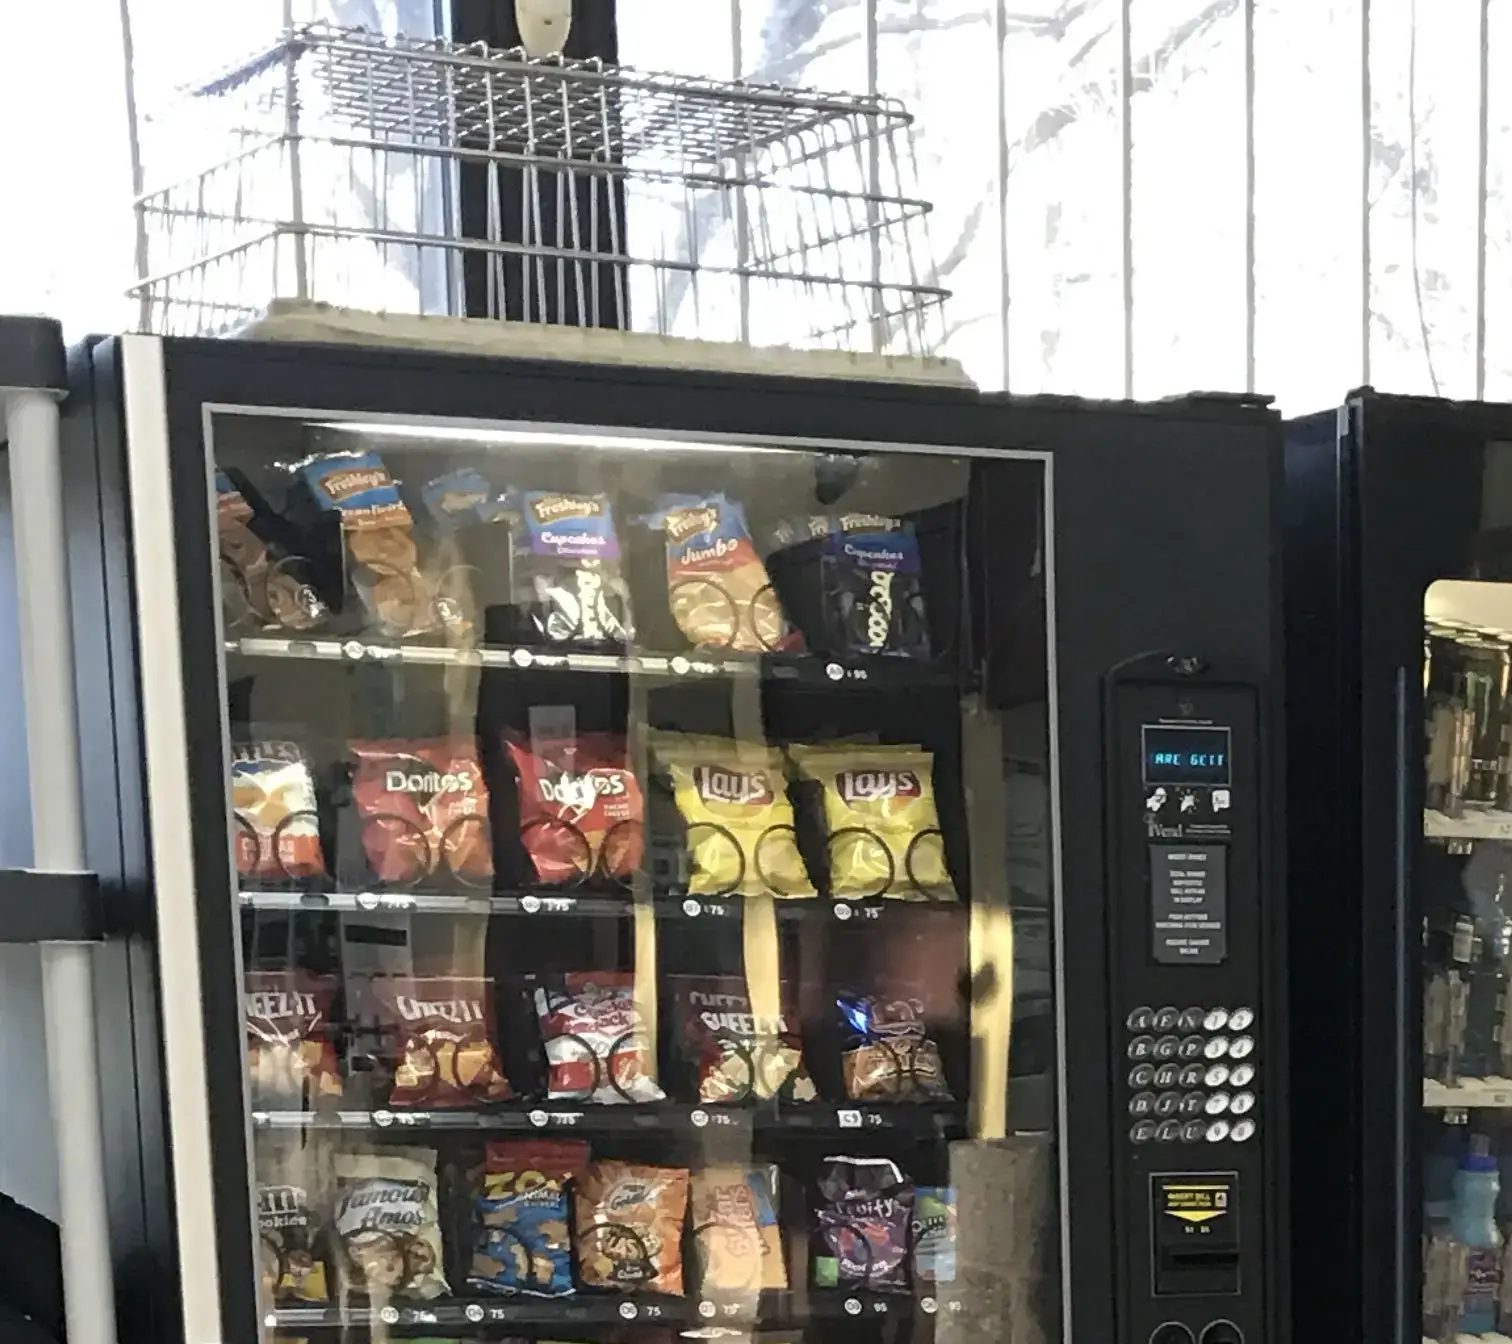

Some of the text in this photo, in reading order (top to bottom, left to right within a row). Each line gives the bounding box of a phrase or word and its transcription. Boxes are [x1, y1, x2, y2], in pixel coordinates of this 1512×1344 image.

[541, 531, 606, 546] Cupcakes
[681, 537, 738, 566] Jumbo
[843, 543, 904, 561] Cupcakes
[1154, 752, 1181, 766] ARE
[385, 770, 475, 794] Doritos
[361, 1204, 426, 1227] Amos
[647, 1305, 662, 1317] 75
